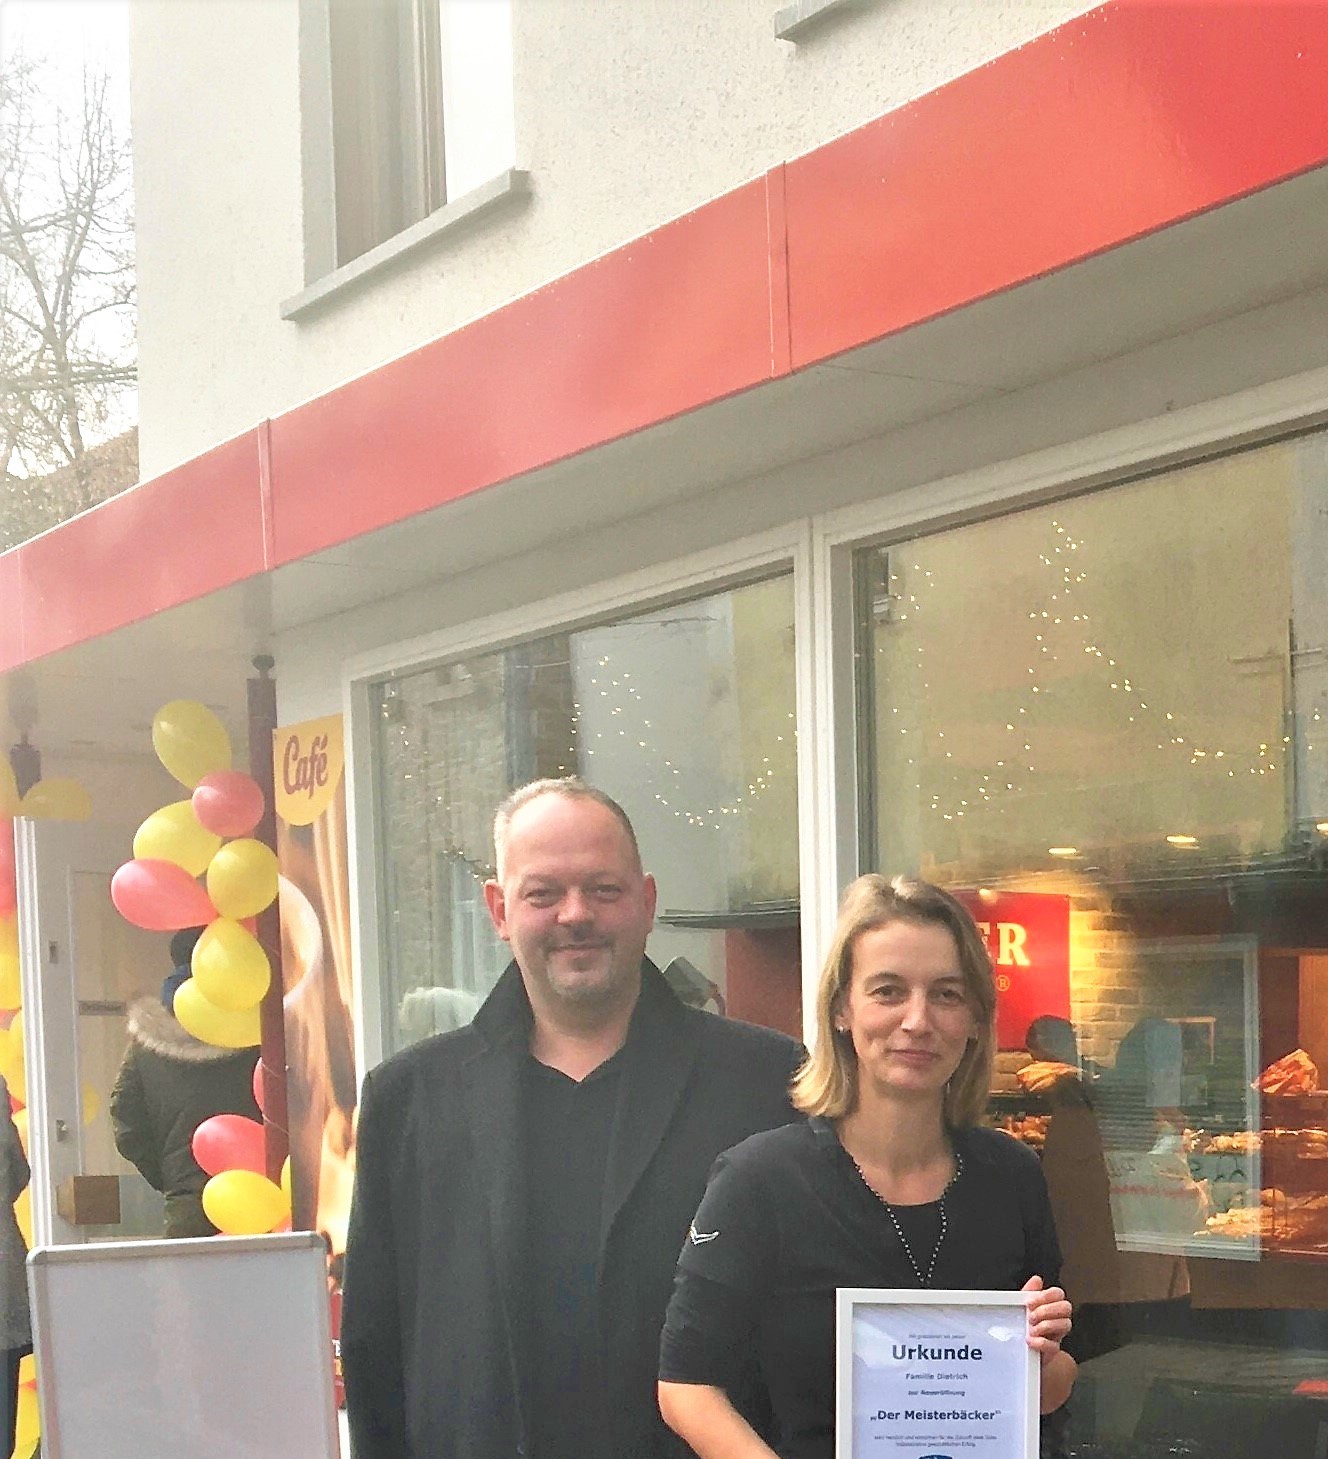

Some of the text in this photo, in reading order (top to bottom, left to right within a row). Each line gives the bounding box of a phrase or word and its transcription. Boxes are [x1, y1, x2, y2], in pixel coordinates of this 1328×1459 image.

[283, 733, 328, 800] Café
[892, 1344, 983, 1361] Urkunde
[936, 1371, 969, 1381] Dietrich
